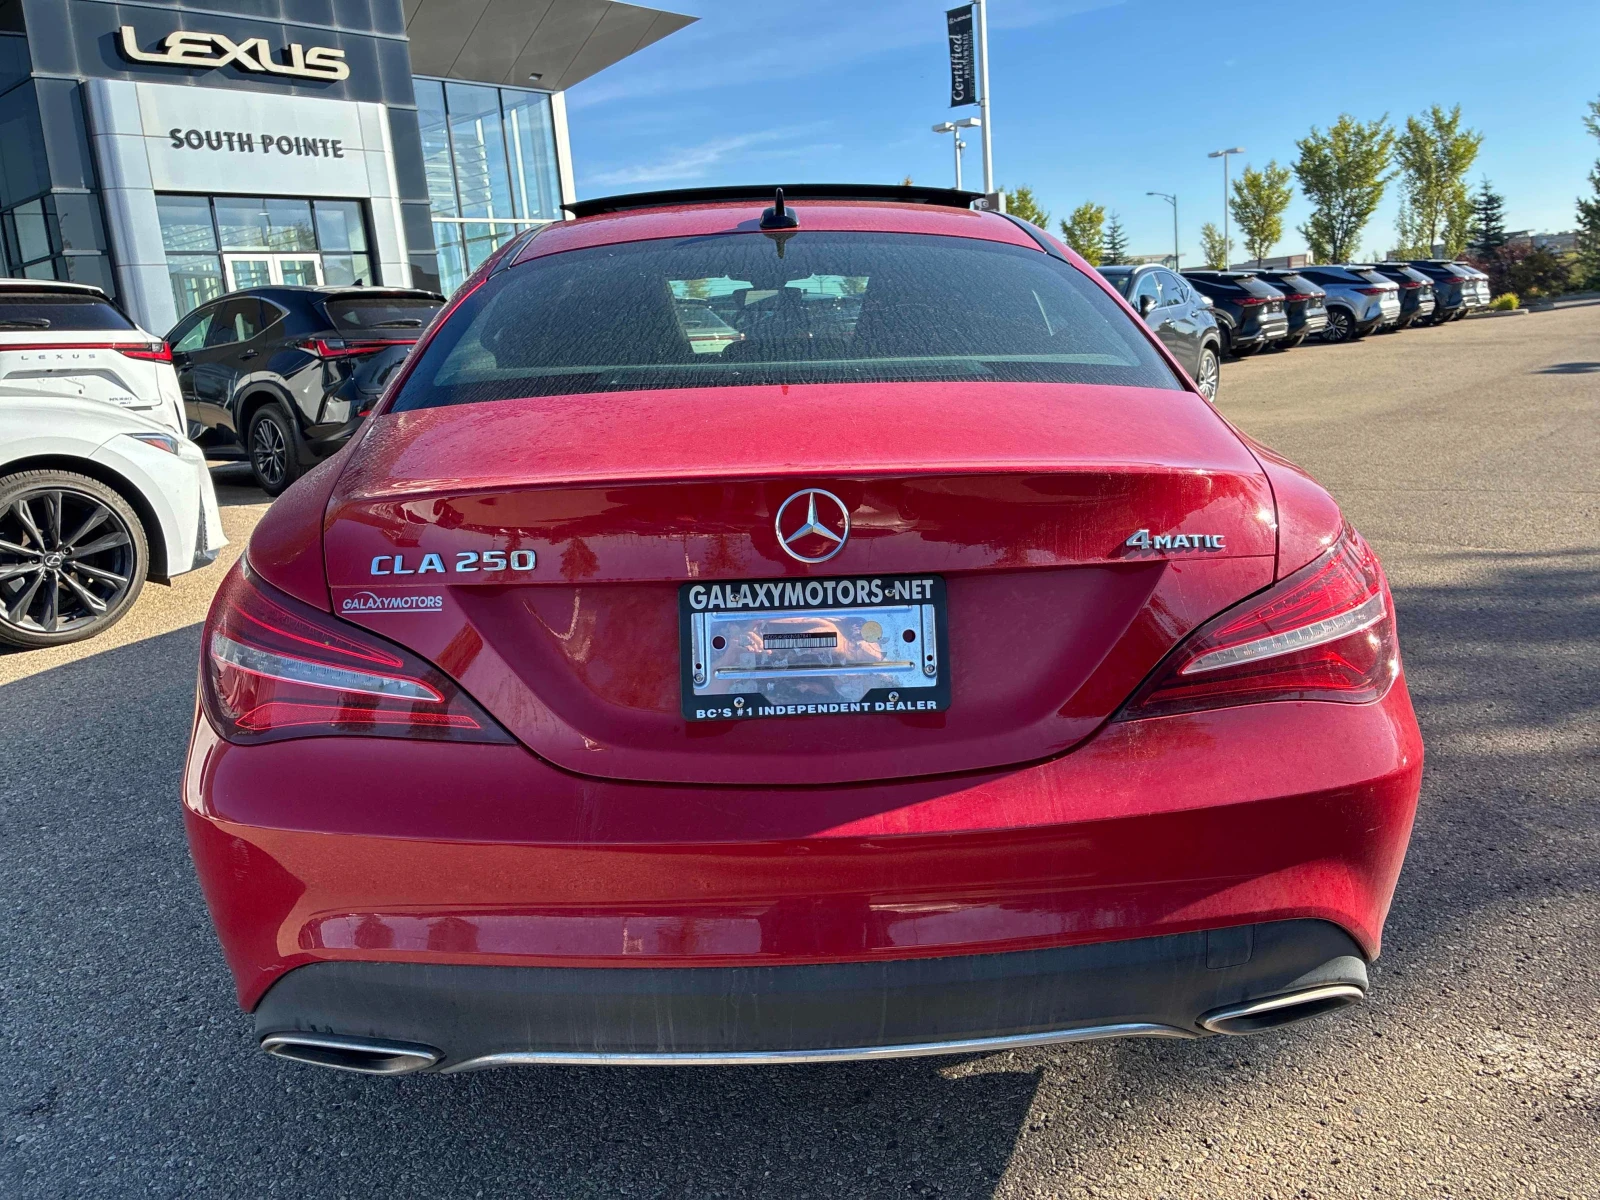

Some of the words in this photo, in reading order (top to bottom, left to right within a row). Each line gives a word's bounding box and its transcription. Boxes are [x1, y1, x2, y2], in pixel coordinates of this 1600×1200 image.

[121, 25, 350, 80] LEXUS
[949, 33, 965, 100] Certified
[169, 128, 252, 152] SOUTH
[261, 134, 344, 158] POINTE
[1126, 528, 1226, 549] 4MATIC
[371, 553, 446, 575] CLA
[456, 550, 536, 573] 250
[342, 594, 442, 610] GALAXYMOTORS
[696, 707, 732, 719] BC'S
[737, 706, 753, 717] #1
[758, 702, 869, 716] INDEPENDENT
[875, 700, 937, 711] DEALER
